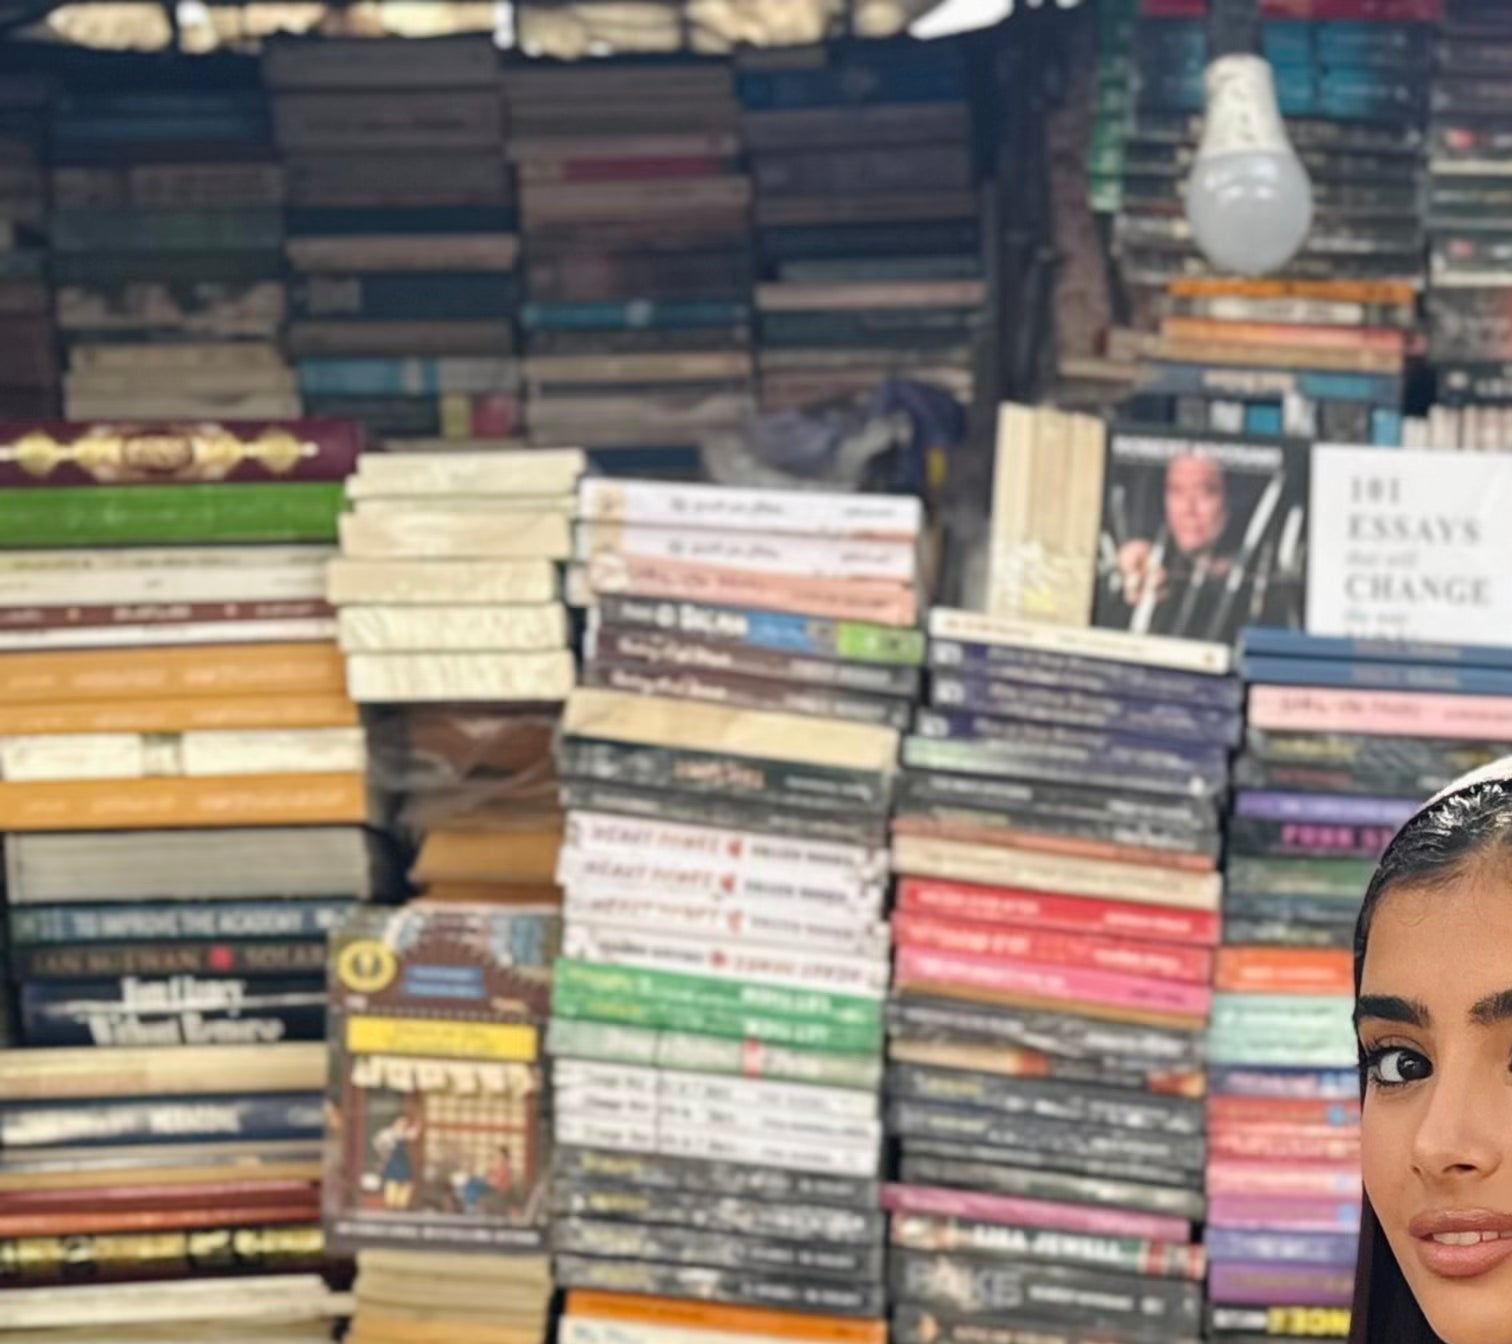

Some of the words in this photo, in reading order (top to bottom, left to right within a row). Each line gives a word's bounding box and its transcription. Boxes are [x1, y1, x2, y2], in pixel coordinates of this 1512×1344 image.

[1349, 476, 1401, 501] 101
[1348, 515, 1480, 545] ESSAYS
[1343, 576, 1491, 606] CHANGE
